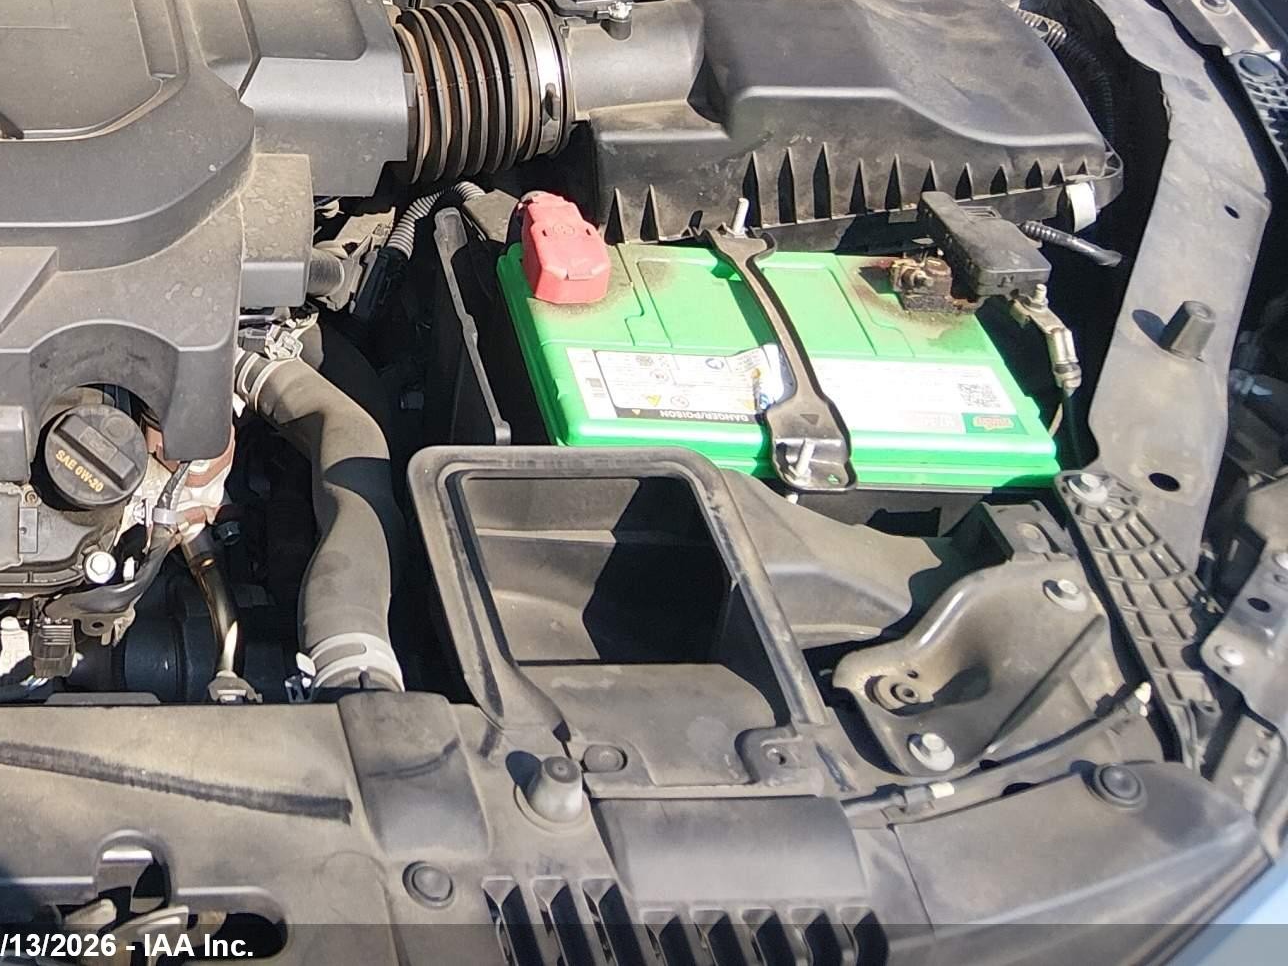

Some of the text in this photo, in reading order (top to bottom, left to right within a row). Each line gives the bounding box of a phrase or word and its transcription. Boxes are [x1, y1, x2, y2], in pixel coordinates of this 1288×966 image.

[659, 409, 750, 422] DANGER/POISON
[55, 449, 104, 493] SAE 0W-20
